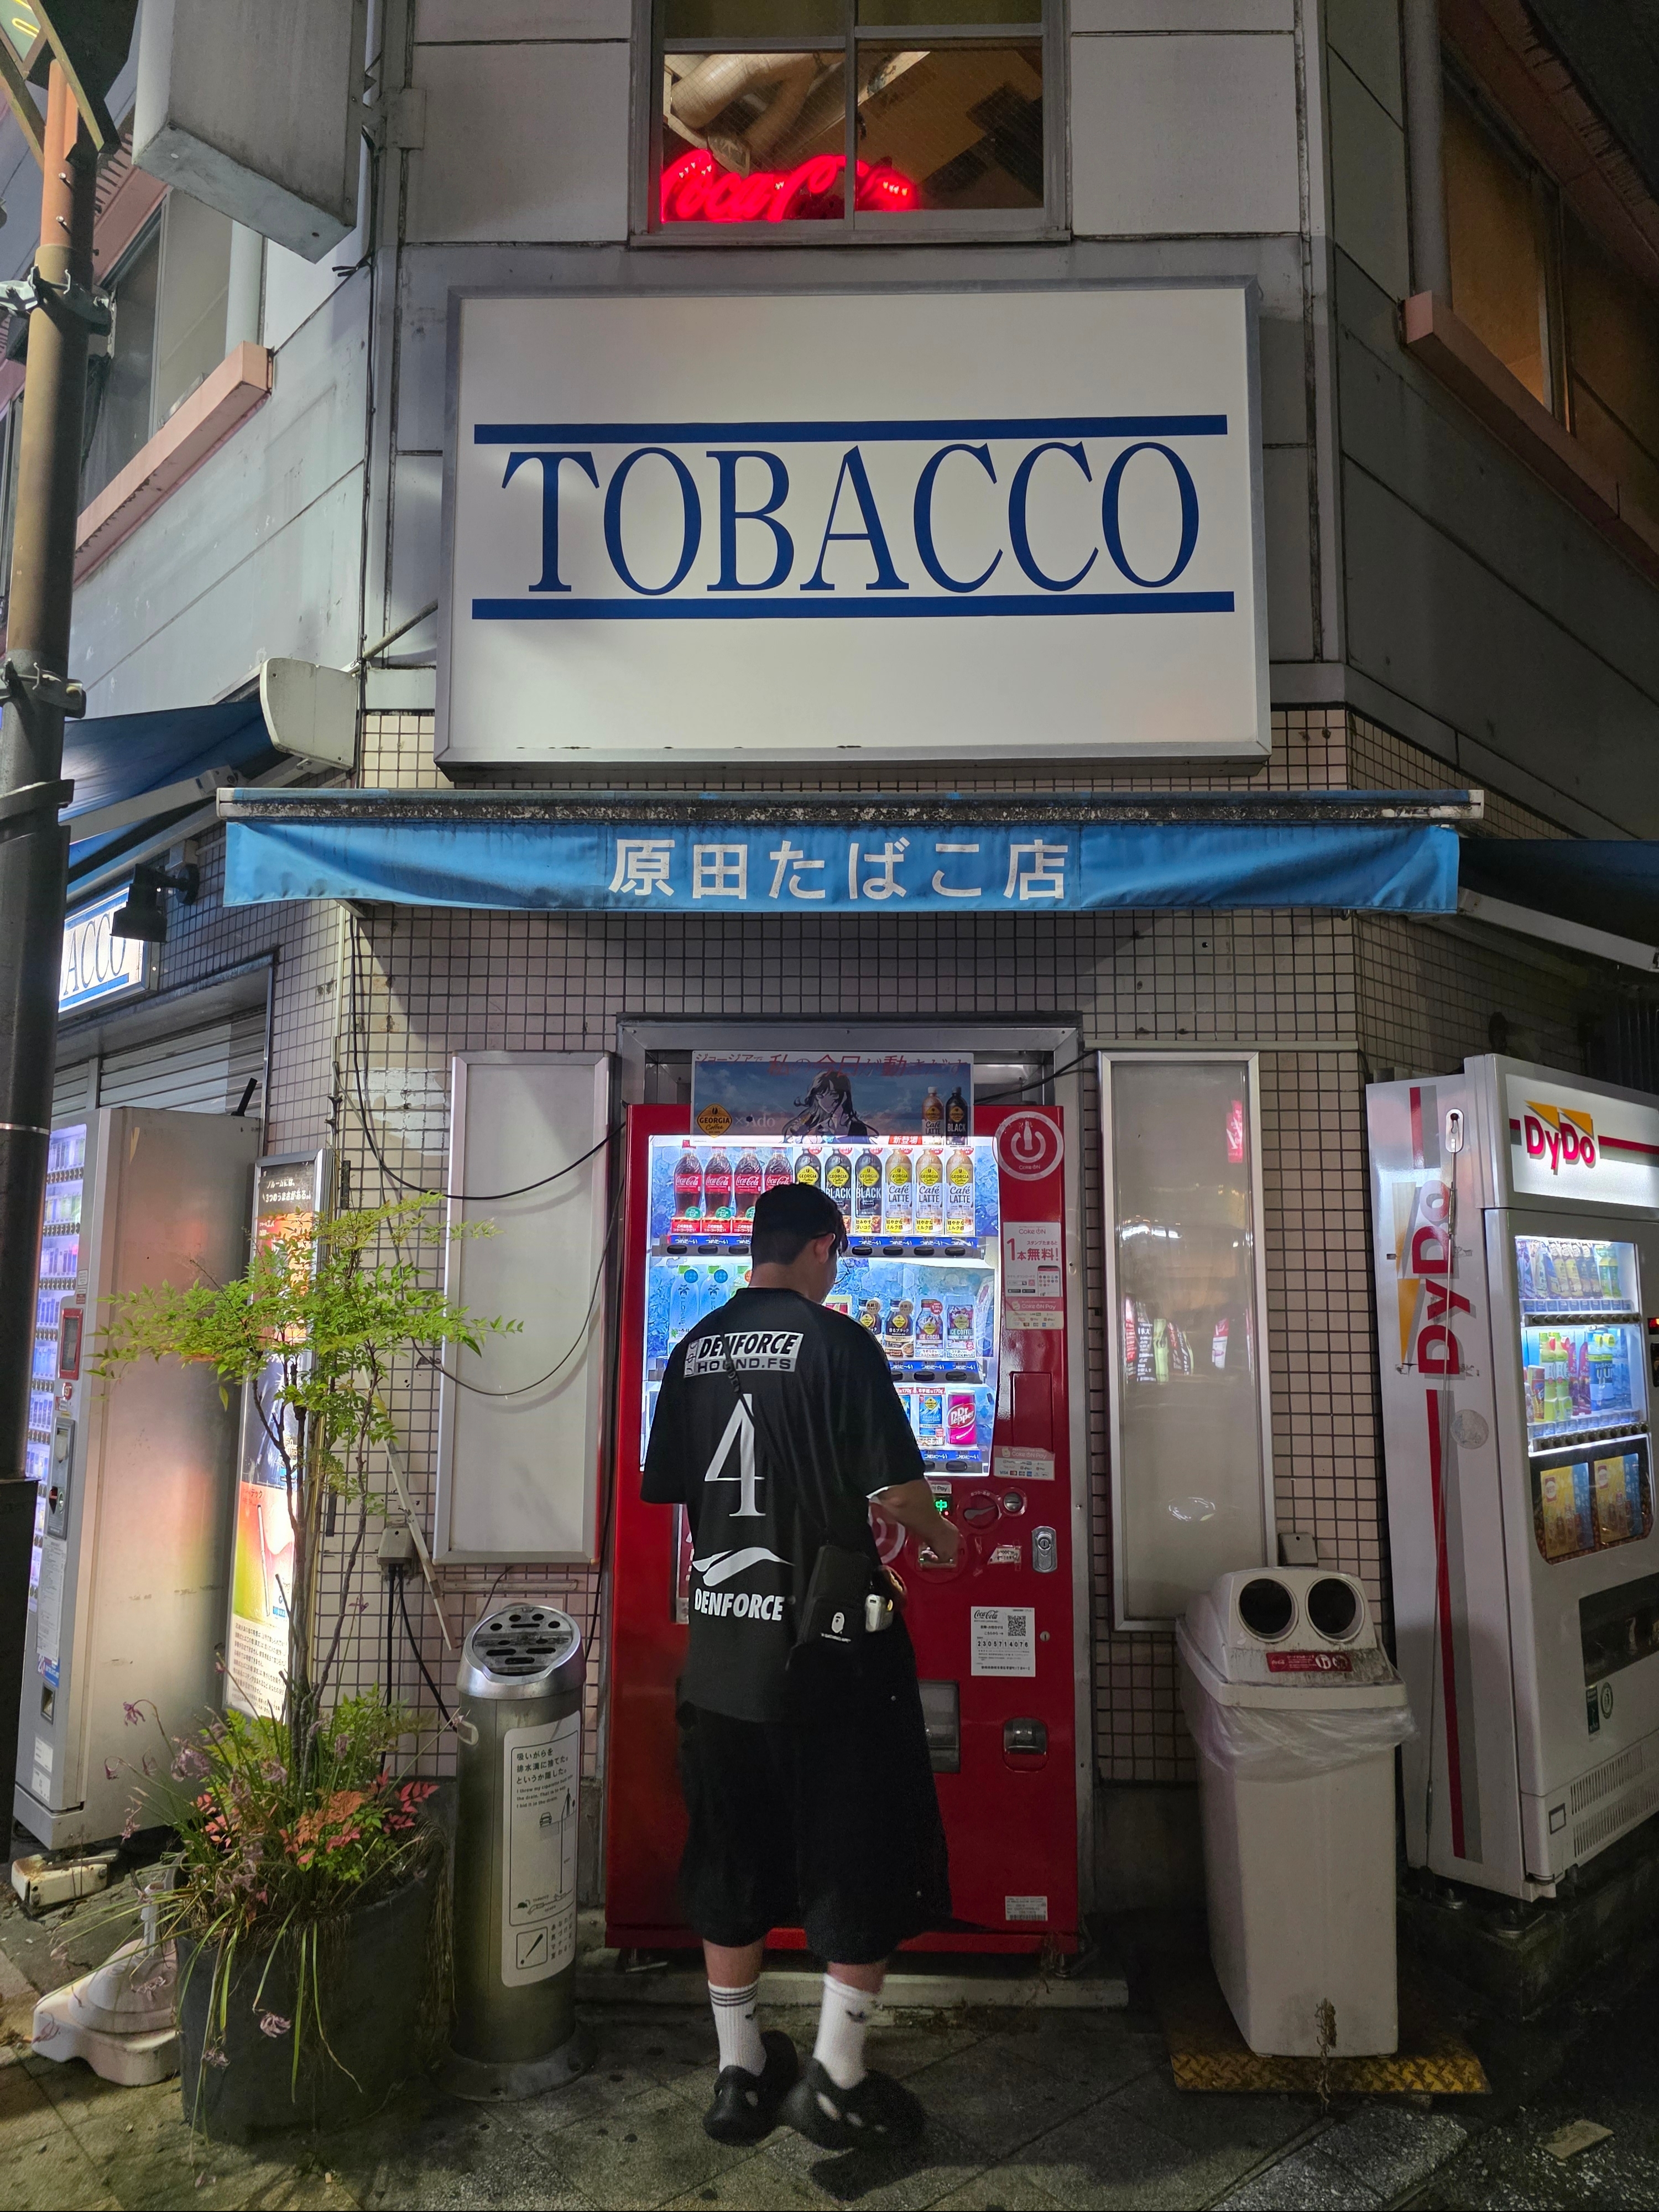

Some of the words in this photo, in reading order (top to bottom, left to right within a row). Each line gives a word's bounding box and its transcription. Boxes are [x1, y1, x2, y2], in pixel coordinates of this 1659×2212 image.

[502, 441, 1199, 596] TOBACCO
[608, 837, 1068, 900] 原田たばこ店
[62, 912, 126, 995] ACCO
[746, 1114, 776, 1128] Ado
[948, 1124, 966, 1133] BLACK
[1524, 1115, 1595, 1170] DyDo
[826, 1187, 851, 1199] BLACK
[857, 1187, 881, 1199] BLACK
[889, 1186, 909, 1194] Café
[919, 1186, 940, 1194] Café
[950, 1186, 971, 1194] Café
[889, 1194, 909, 1203] LATTE
[919, 1194, 940, 1203] LATTE
[950, 1194, 971, 1203] LATTE
[1006, 1238, 1059, 1261] 1本無料!
[1412, 1180, 1470, 1375] DyDo
[697, 1333, 799, 1359] DENFORCE
[951, 1411, 974, 1425] Pepper
[957, 1407, 969, 1415] Dr
[704, 1394, 766, 1516] 4
[935, 1499, 947, 1511] 中
[694, 1588, 785, 1621] DENFORCE
[517, 1747, 553, 1761] 吸いがらを
[517, 1755, 568, 1773] 排水溝に捨てた。
[517, 1767, 567, 1785] というか隠した。
